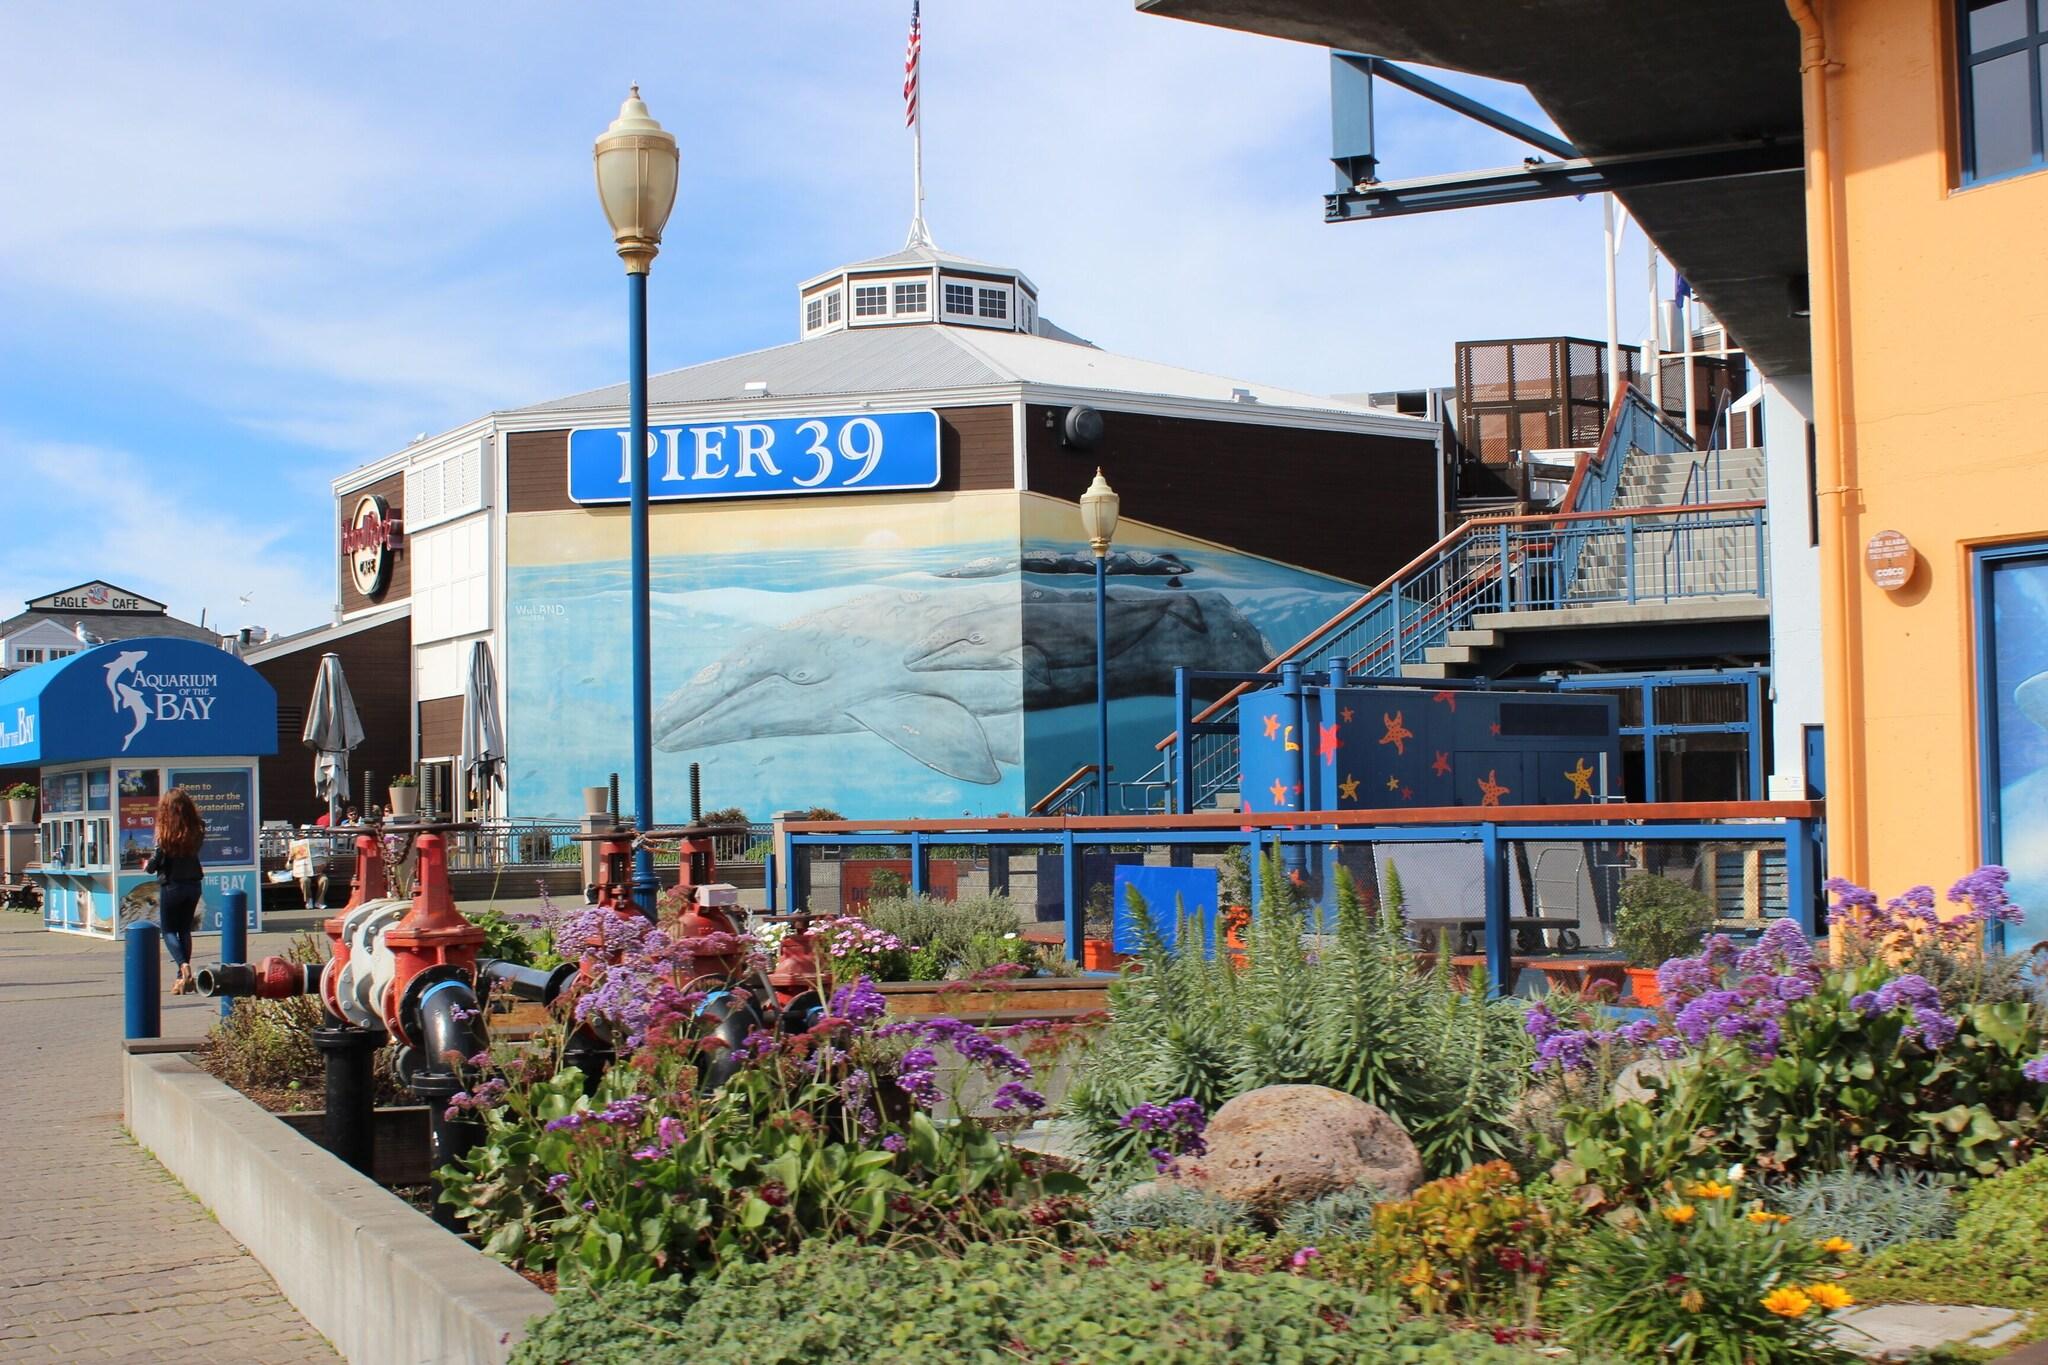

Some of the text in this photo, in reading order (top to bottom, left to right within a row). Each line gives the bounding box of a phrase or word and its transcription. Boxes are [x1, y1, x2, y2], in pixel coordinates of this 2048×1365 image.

[617, 418, 884, 487] PIER 39
[54, 597, 139, 610] EAGLE CAFE
[131, 670, 217, 692] AQUARIUM
[178, 688, 210, 696] OF THE
[155, 693, 217, 721] BAY
[226, 791, 241, 800] the
[204, 874, 247, 891] THE BAY
